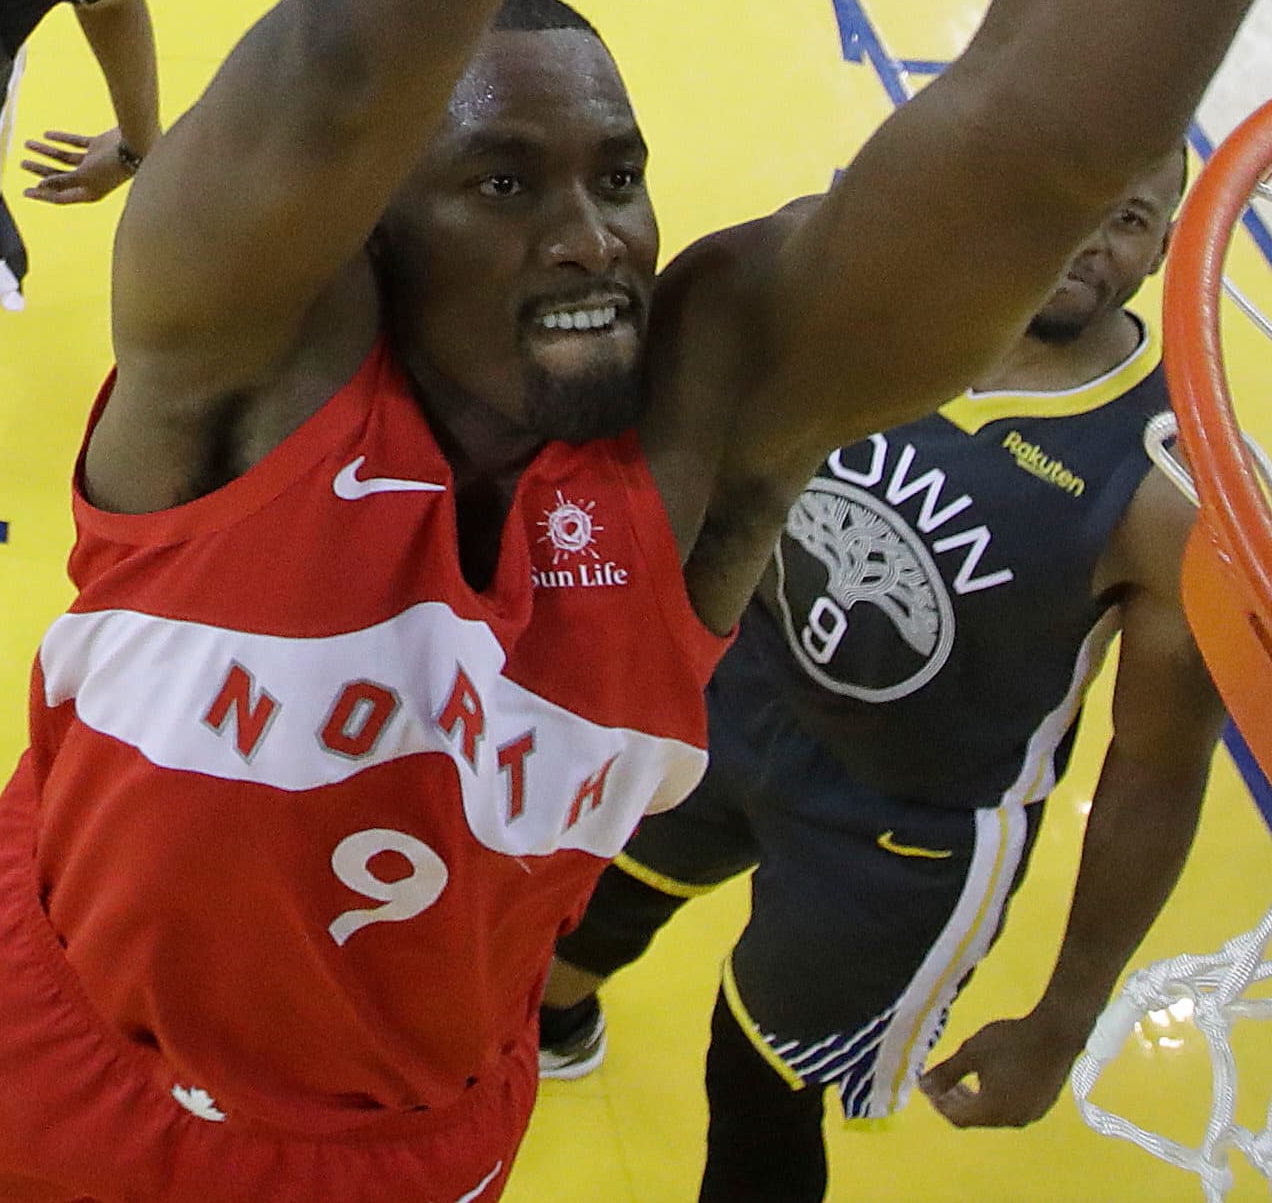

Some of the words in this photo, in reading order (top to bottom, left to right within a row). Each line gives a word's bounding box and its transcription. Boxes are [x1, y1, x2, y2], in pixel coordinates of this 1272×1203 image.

[1003, 431, 1086, 497] Rakuten
[828, 432, 1014, 595] OWN
[578, 561, 628, 587] Life
[802, 597, 848, 664] 9
[203, 659, 622, 831] NORTH
[329, 828, 449, 947] 9
